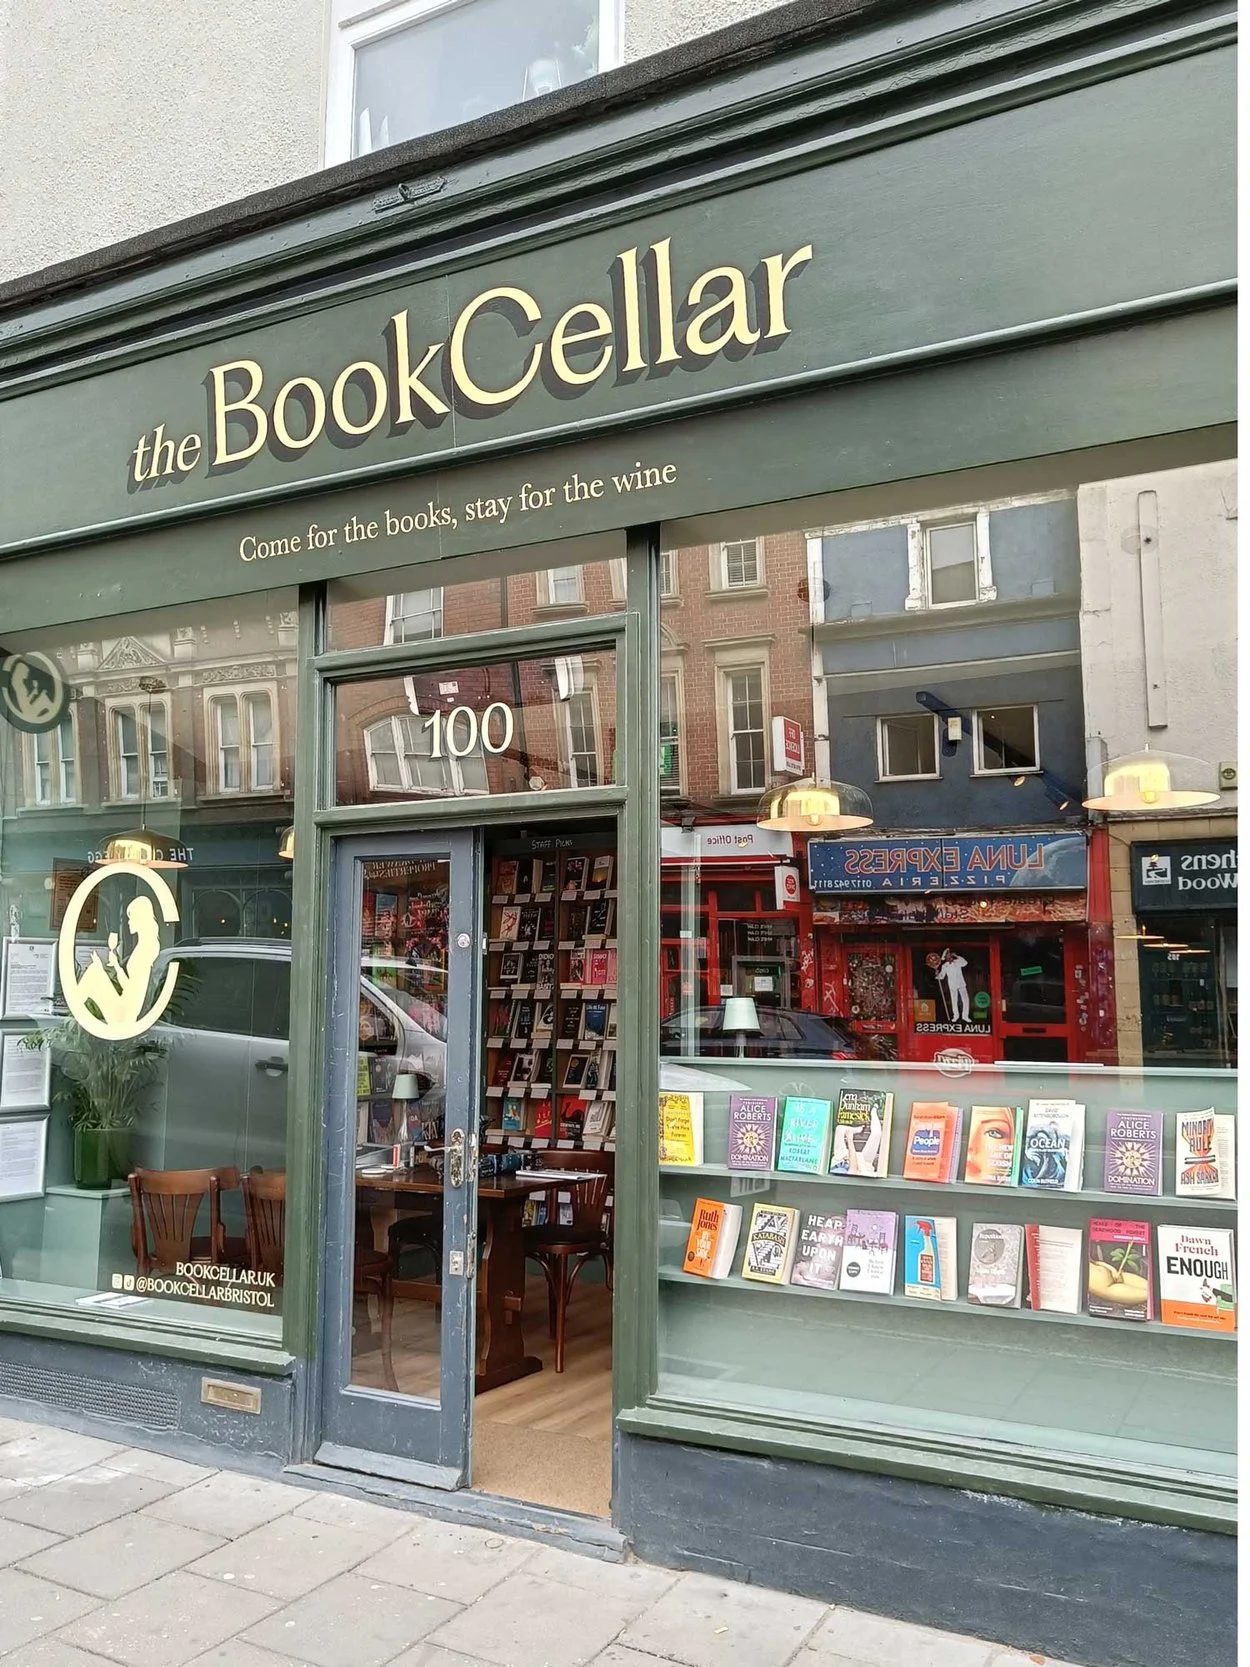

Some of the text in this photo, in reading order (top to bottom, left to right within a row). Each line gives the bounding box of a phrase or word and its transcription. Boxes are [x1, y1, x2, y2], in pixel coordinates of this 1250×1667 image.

[132, 421, 202, 484] the
[239, 460, 677, 564] Come for the books, stay for the wine
[424, 702, 514, 758] 100
[740, 1105, 767, 1113] ALICE
[733, 1112, 772, 1121] ROBERTS
[1118, 1120, 1150, 1130] ALICE
[1110, 1128, 1157, 1139] ROBERTS
[913, 1135, 940, 1148] People
[1030, 1138, 1066, 1149] OCEAN
[730, 1154, 769, 1162] DOMINATION
[1108, 1175, 1155, 1185] DOMINATION
[700, 1208, 719, 1223] Ruth
[808, 1214, 842, 1230] HEAP
[697, 1219, 719, 1231] Jones
[801, 1229, 844, 1247] EARTH
[1181, 1234, 1212, 1246] Dawn
[802, 1245, 836, 1261] UPON
[1175, 1242, 1219, 1257] French
[175, 1261, 276, 1288] BOOKCELLAR.UK
[809, 1262, 822, 1274] IT
[1166, 1255, 1229, 1281] ENOUGH
[136, 1276, 275, 1308] @BOOKCELLARBRISTOL
